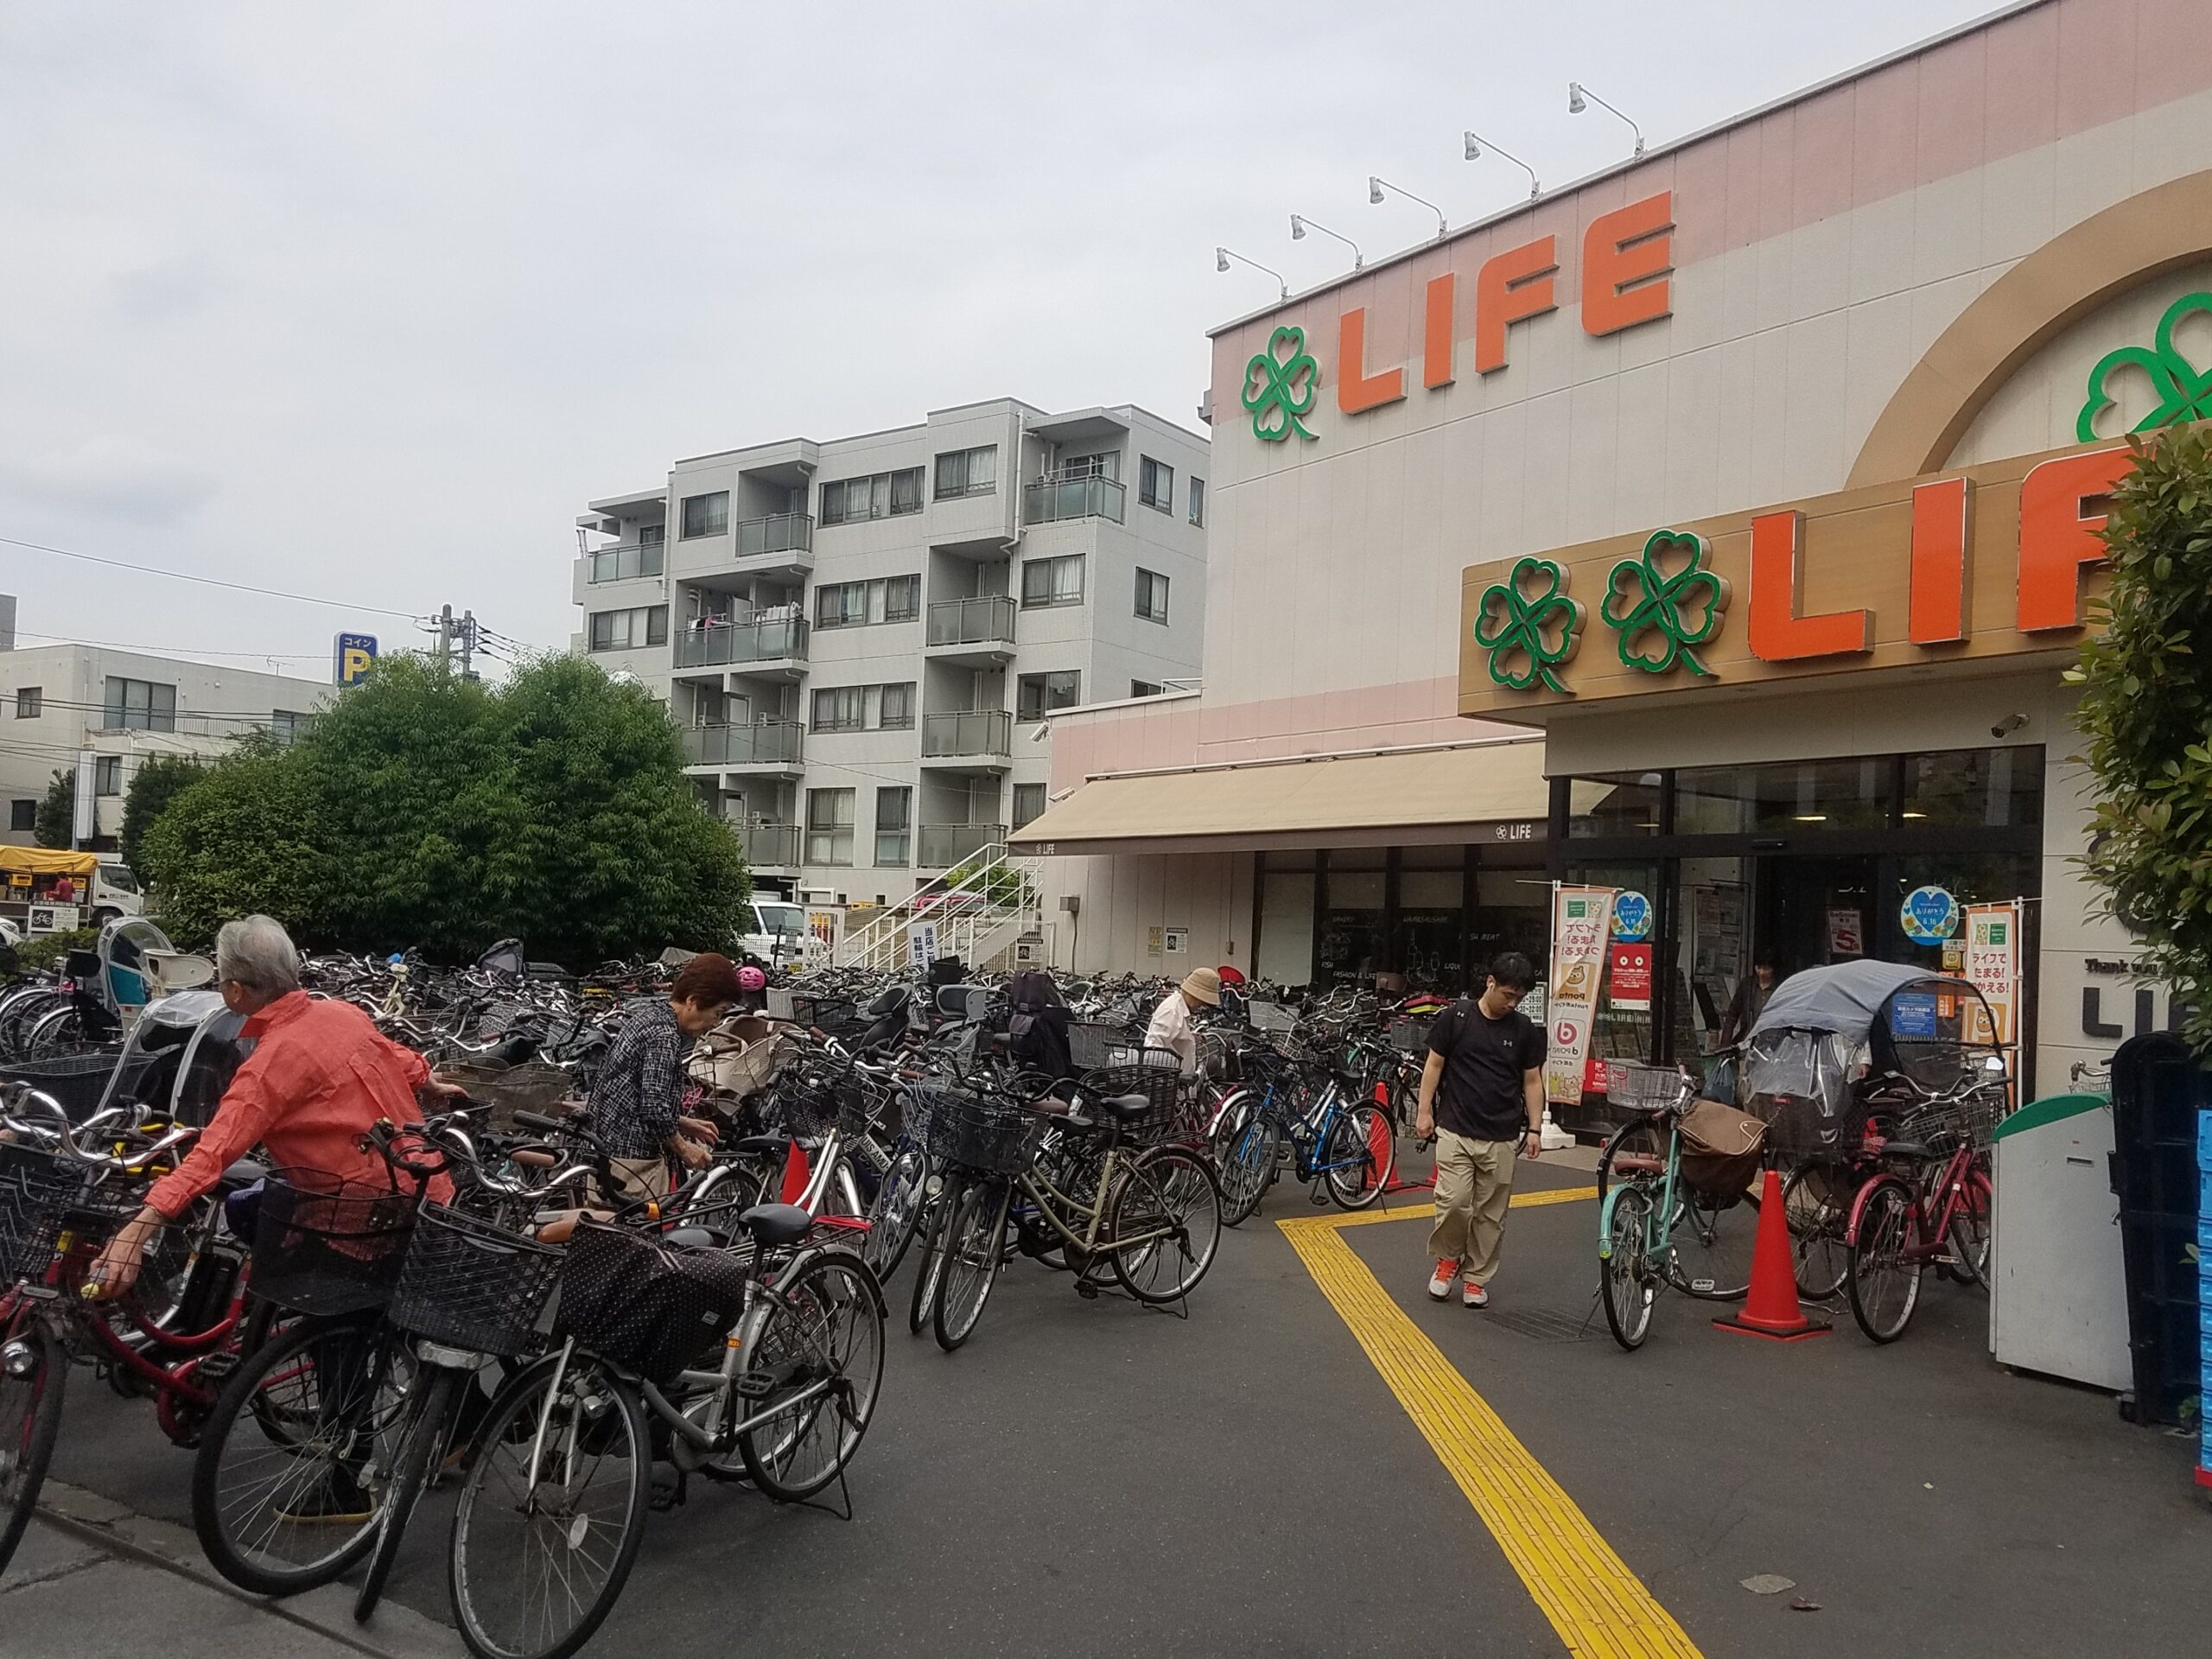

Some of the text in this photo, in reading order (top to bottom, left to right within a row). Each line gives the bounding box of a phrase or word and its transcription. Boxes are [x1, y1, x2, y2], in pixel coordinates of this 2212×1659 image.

[1338, 190, 1675, 415] LIFE
[1748, 441, 2158, 662] LIF
[345, 638, 372, 647] コイン
[344, 648, 371, 682] P
[1510, 824, 1531, 839] LIFE
[1043, 843, 1054, 855] LIFE
[1973, 953, 2006, 964] ライフで
[1444, 962, 1461, 971] LIQU
[2084, 958, 2129, 974] Thank
[1332, 970, 1357, 979] FASHION
[1974, 967, 2005, 978] たまる!
